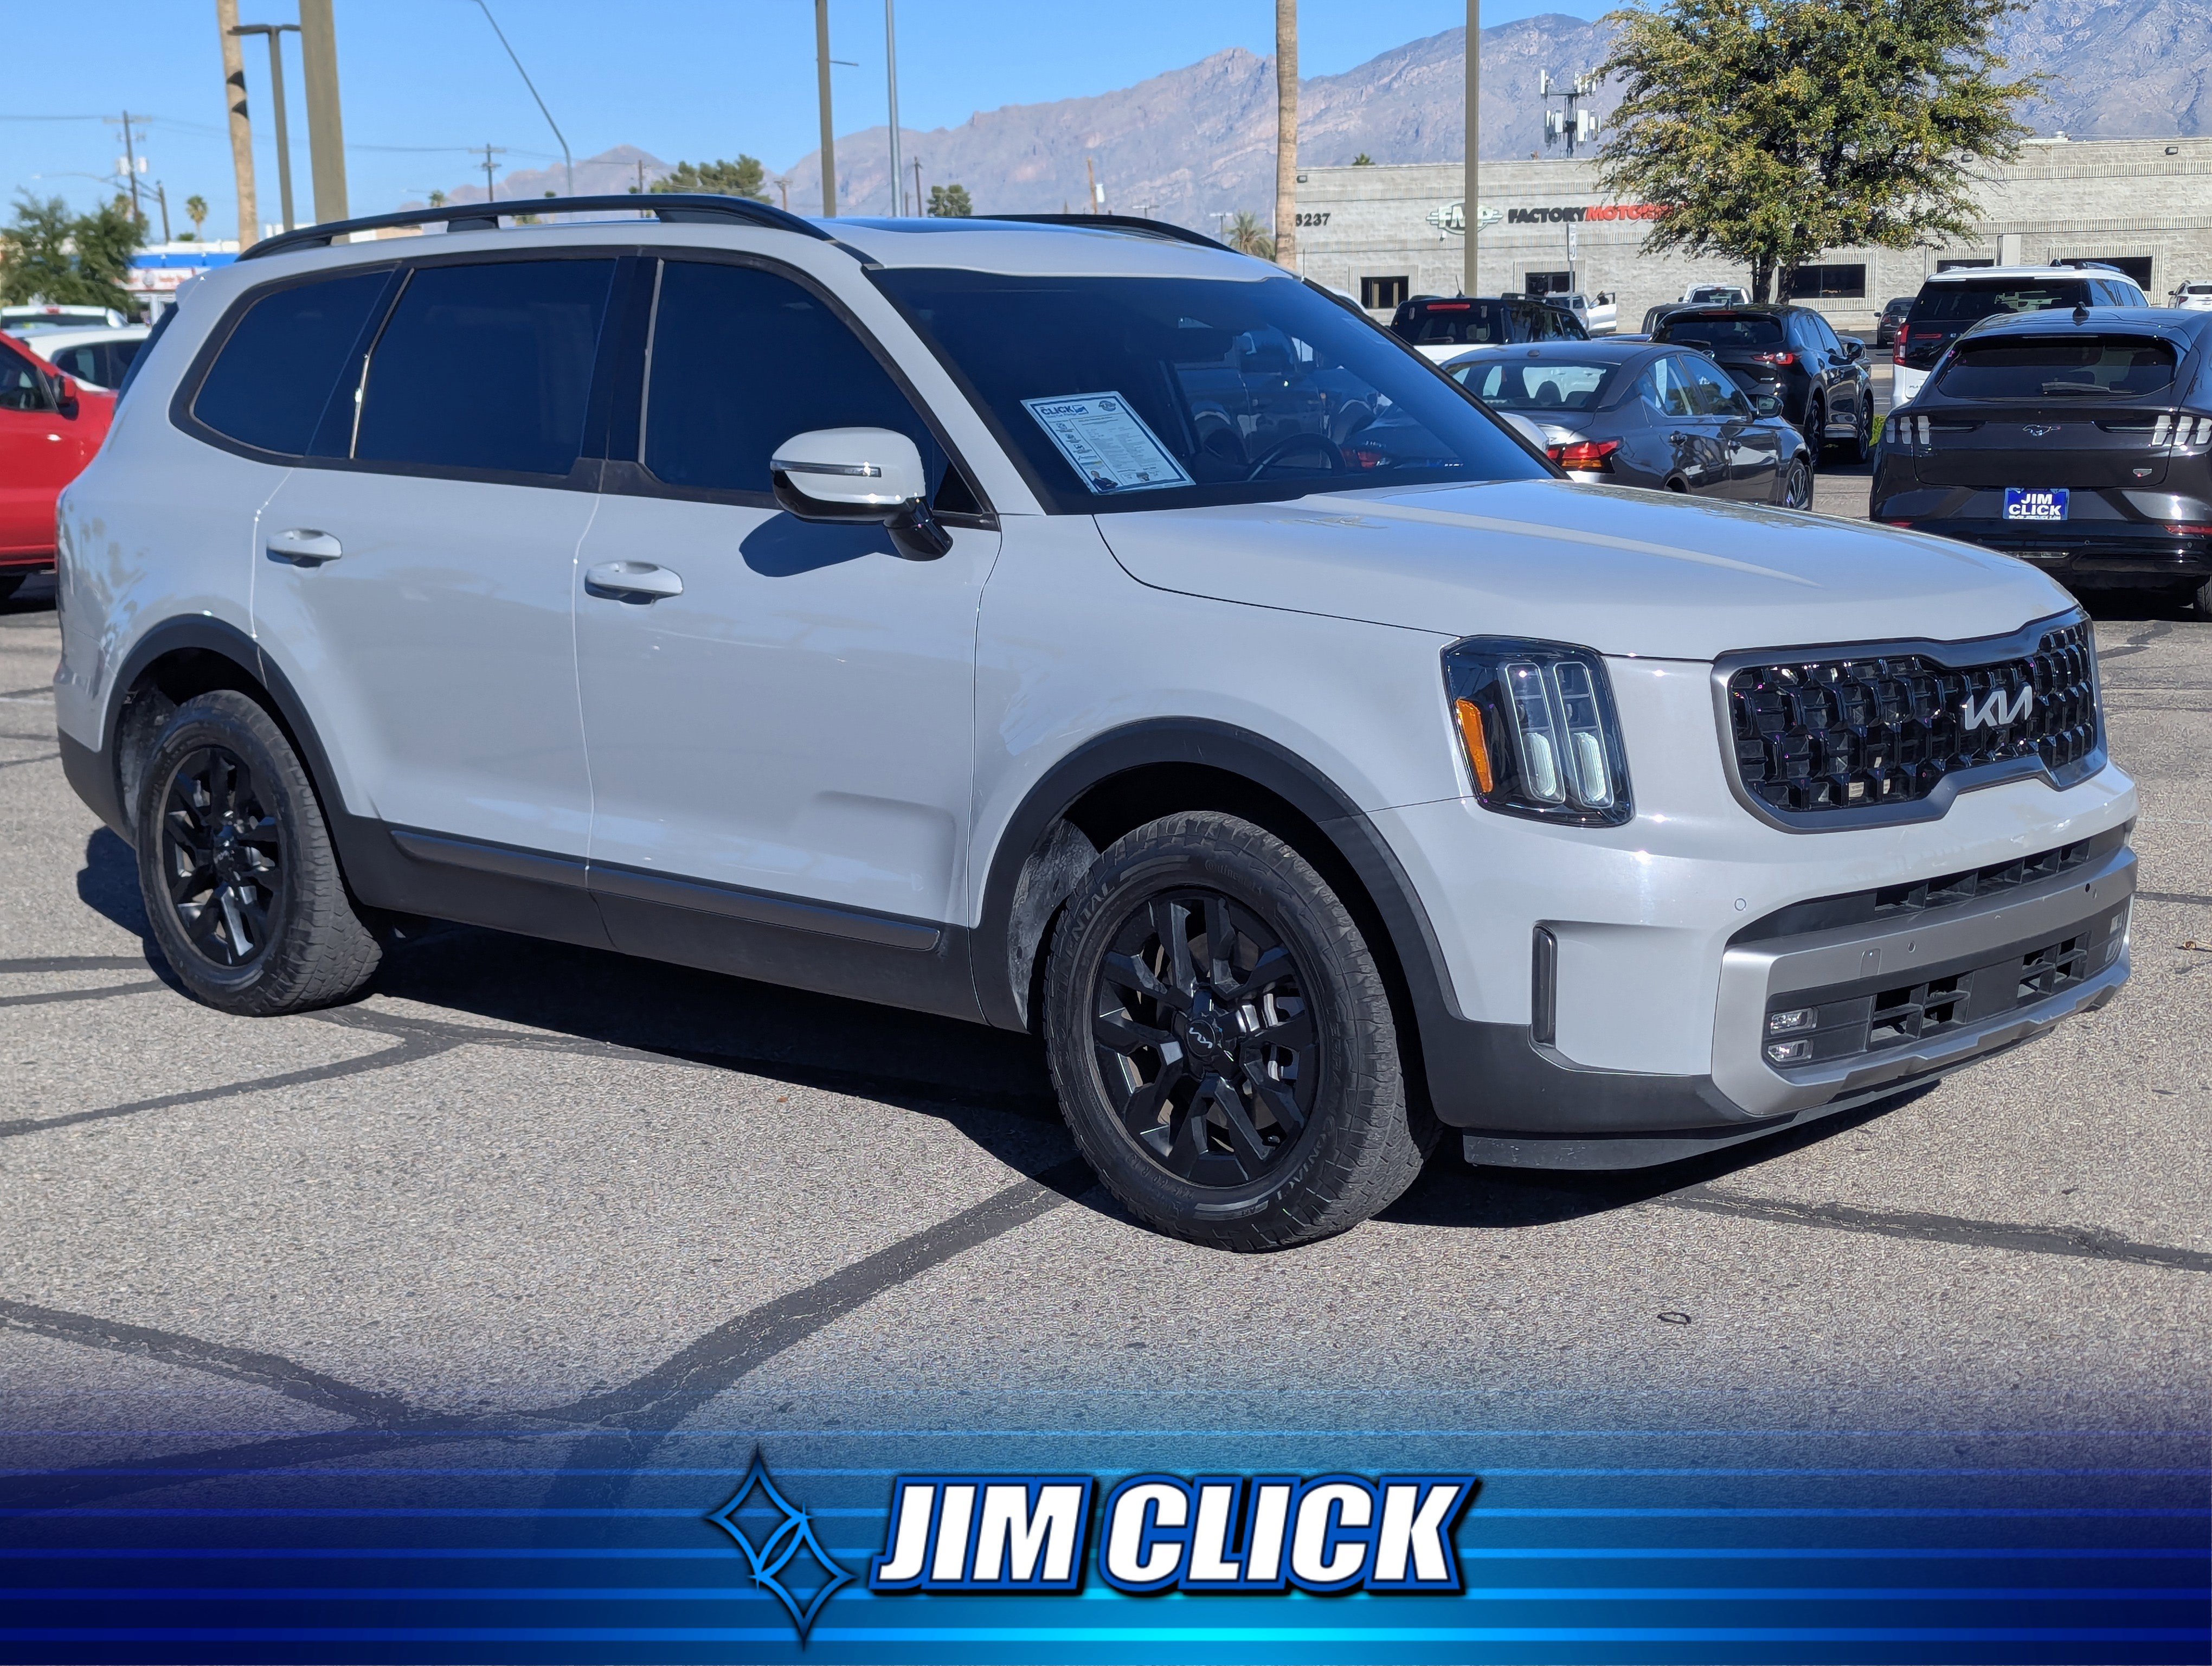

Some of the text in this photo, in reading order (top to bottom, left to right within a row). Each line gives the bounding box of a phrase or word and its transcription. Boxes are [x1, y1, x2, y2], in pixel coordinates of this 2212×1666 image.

[1508, 207, 1587, 223] FACTORY
[1040, 406, 1073, 415] CLICK
[2021, 494, 2053, 504] JIM
[2008, 504, 2062, 516] CLICK
[1964, 684, 2033, 731] KIA
